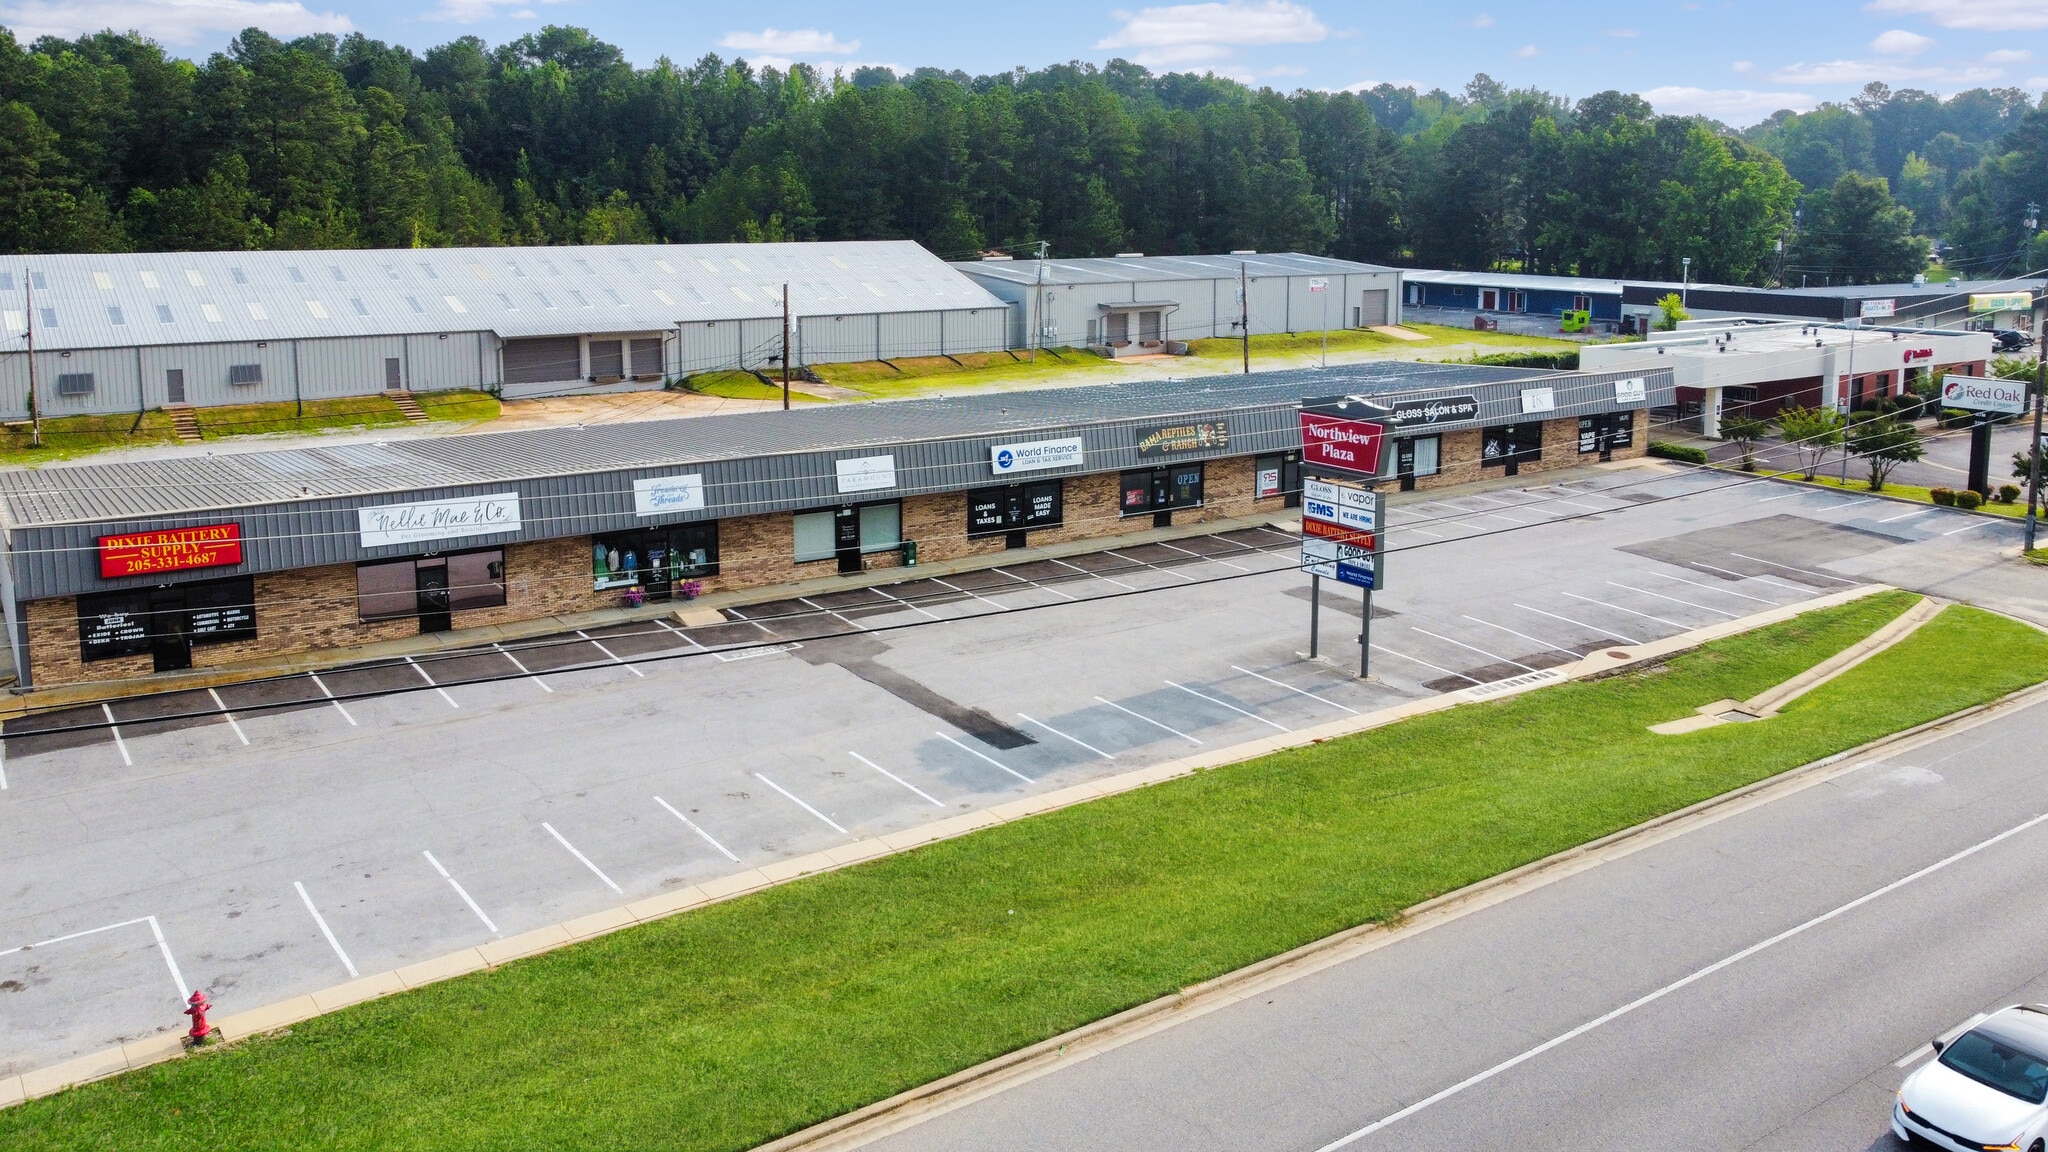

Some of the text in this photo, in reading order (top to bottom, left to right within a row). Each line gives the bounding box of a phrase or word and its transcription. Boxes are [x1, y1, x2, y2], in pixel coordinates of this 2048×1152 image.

[1966, 386, 2020, 402] Red Oak
[1396, 404, 1473, 419] GLOSS SALON & SPA
[1139, 431, 1161, 452] BAMA
[1162, 426, 1196, 439] REPTILES
[1309, 423, 1370, 445] Northview
[1171, 438, 1198, 450] RANCH
[1016, 444, 1078, 458] World Finance
[1322, 443, 1354, 462] Plaza
[842, 473, 892, 483] PARAMOUNT
[1177, 473, 1200, 484] OPEN
[1311, 484, 1332, 493] GLOSS
[650, 495, 684, 507] Threads
[1348, 492, 1374, 505] vapor
[975, 503, 995, 511] LOANS
[378, 499, 506, 537] Nellie Mae & Co.
[976, 516, 995, 525] TAXES
[1359, 515, 1372, 524] HIRING
[107, 527, 231, 550] DIXIE BATTERY
[1306, 521, 1372, 546] DIXIE BATTERY SUPPLY
[141, 542, 201, 558] SUPPLY
[127, 552, 217, 572] 205-331-4687
[1358, 573, 1373, 581] Finance
[96, 622, 134, 630] Batteries!
